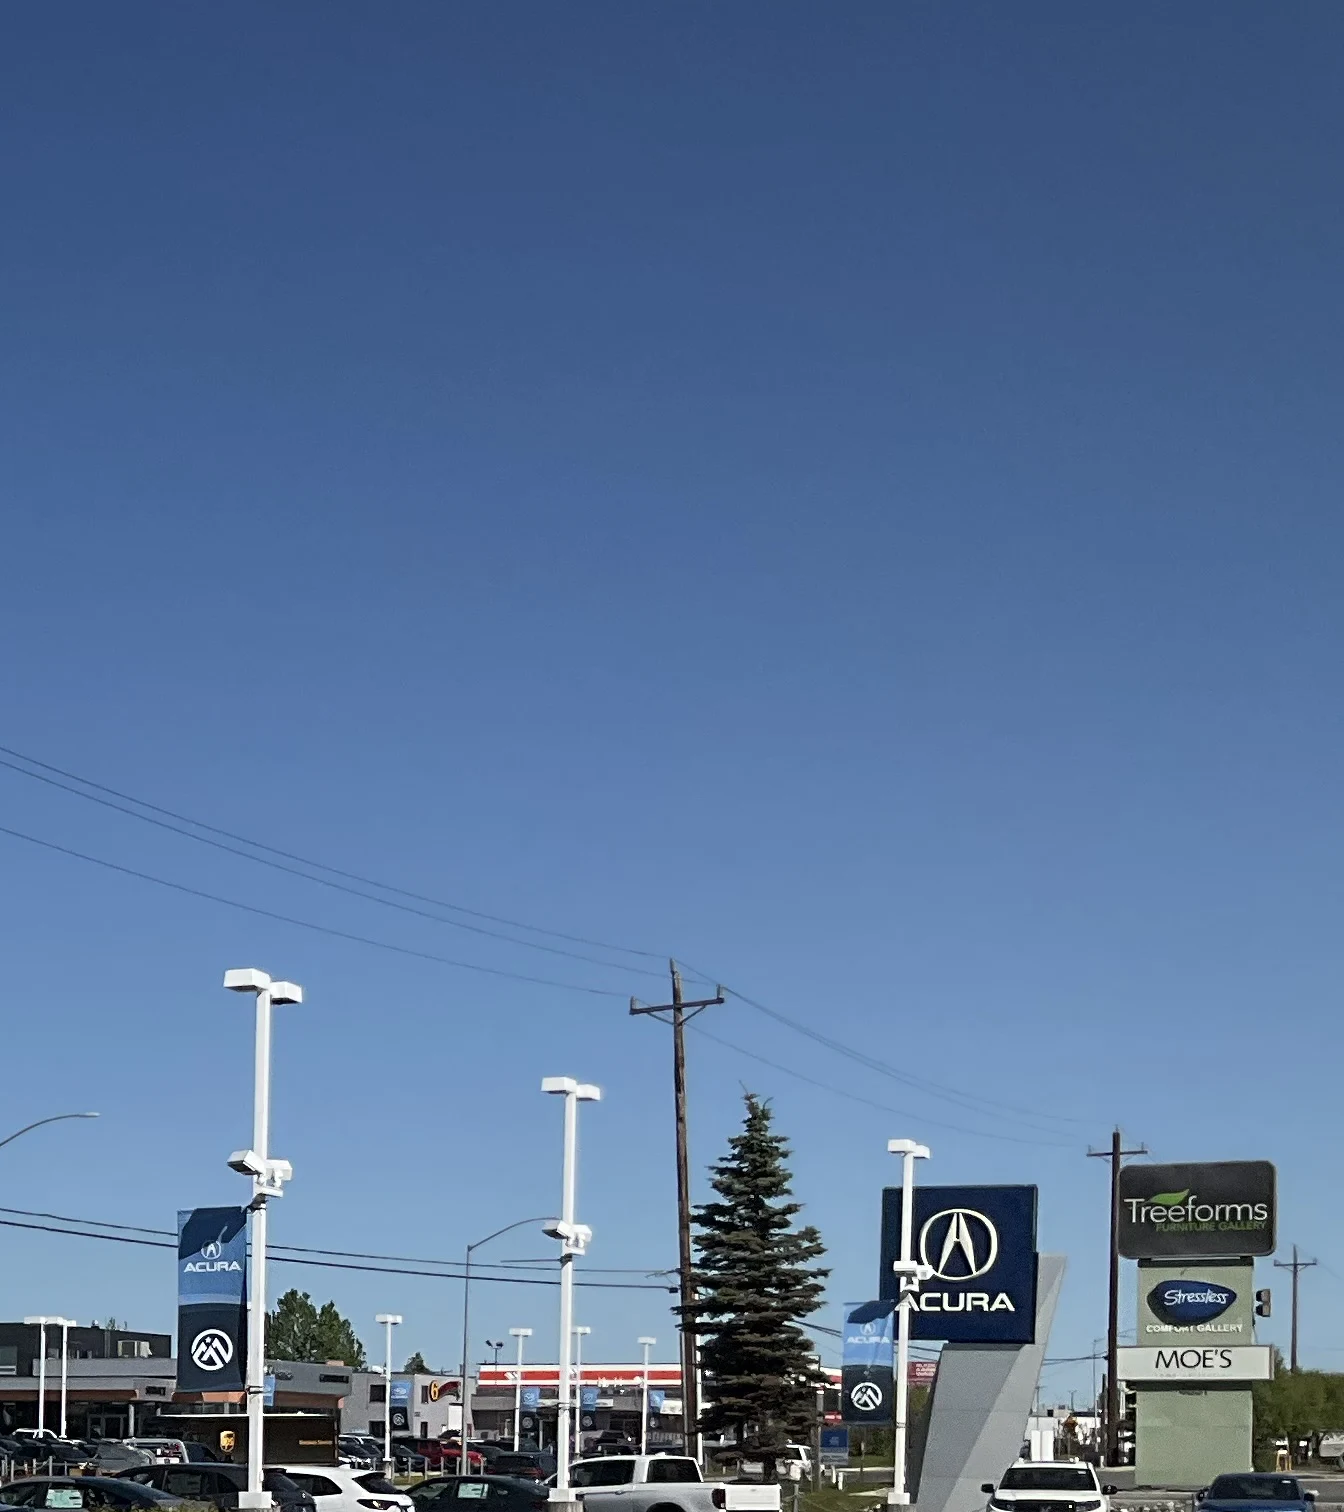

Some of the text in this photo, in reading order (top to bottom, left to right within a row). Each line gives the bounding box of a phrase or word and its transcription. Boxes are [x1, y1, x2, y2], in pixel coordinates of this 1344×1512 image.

[1123, 1195, 1268, 1224] Treeforms
[184, 1261, 242, 1273] ACURA
[895, 1292, 1015, 1312] ACURA
[1164, 1288, 1230, 1306] Stressless
[1196, 1323, 1243, 1333] GALLERY
[847, 1335, 890, 1344] ACURA
[1155, 1349, 1232, 1369] MOE'S
